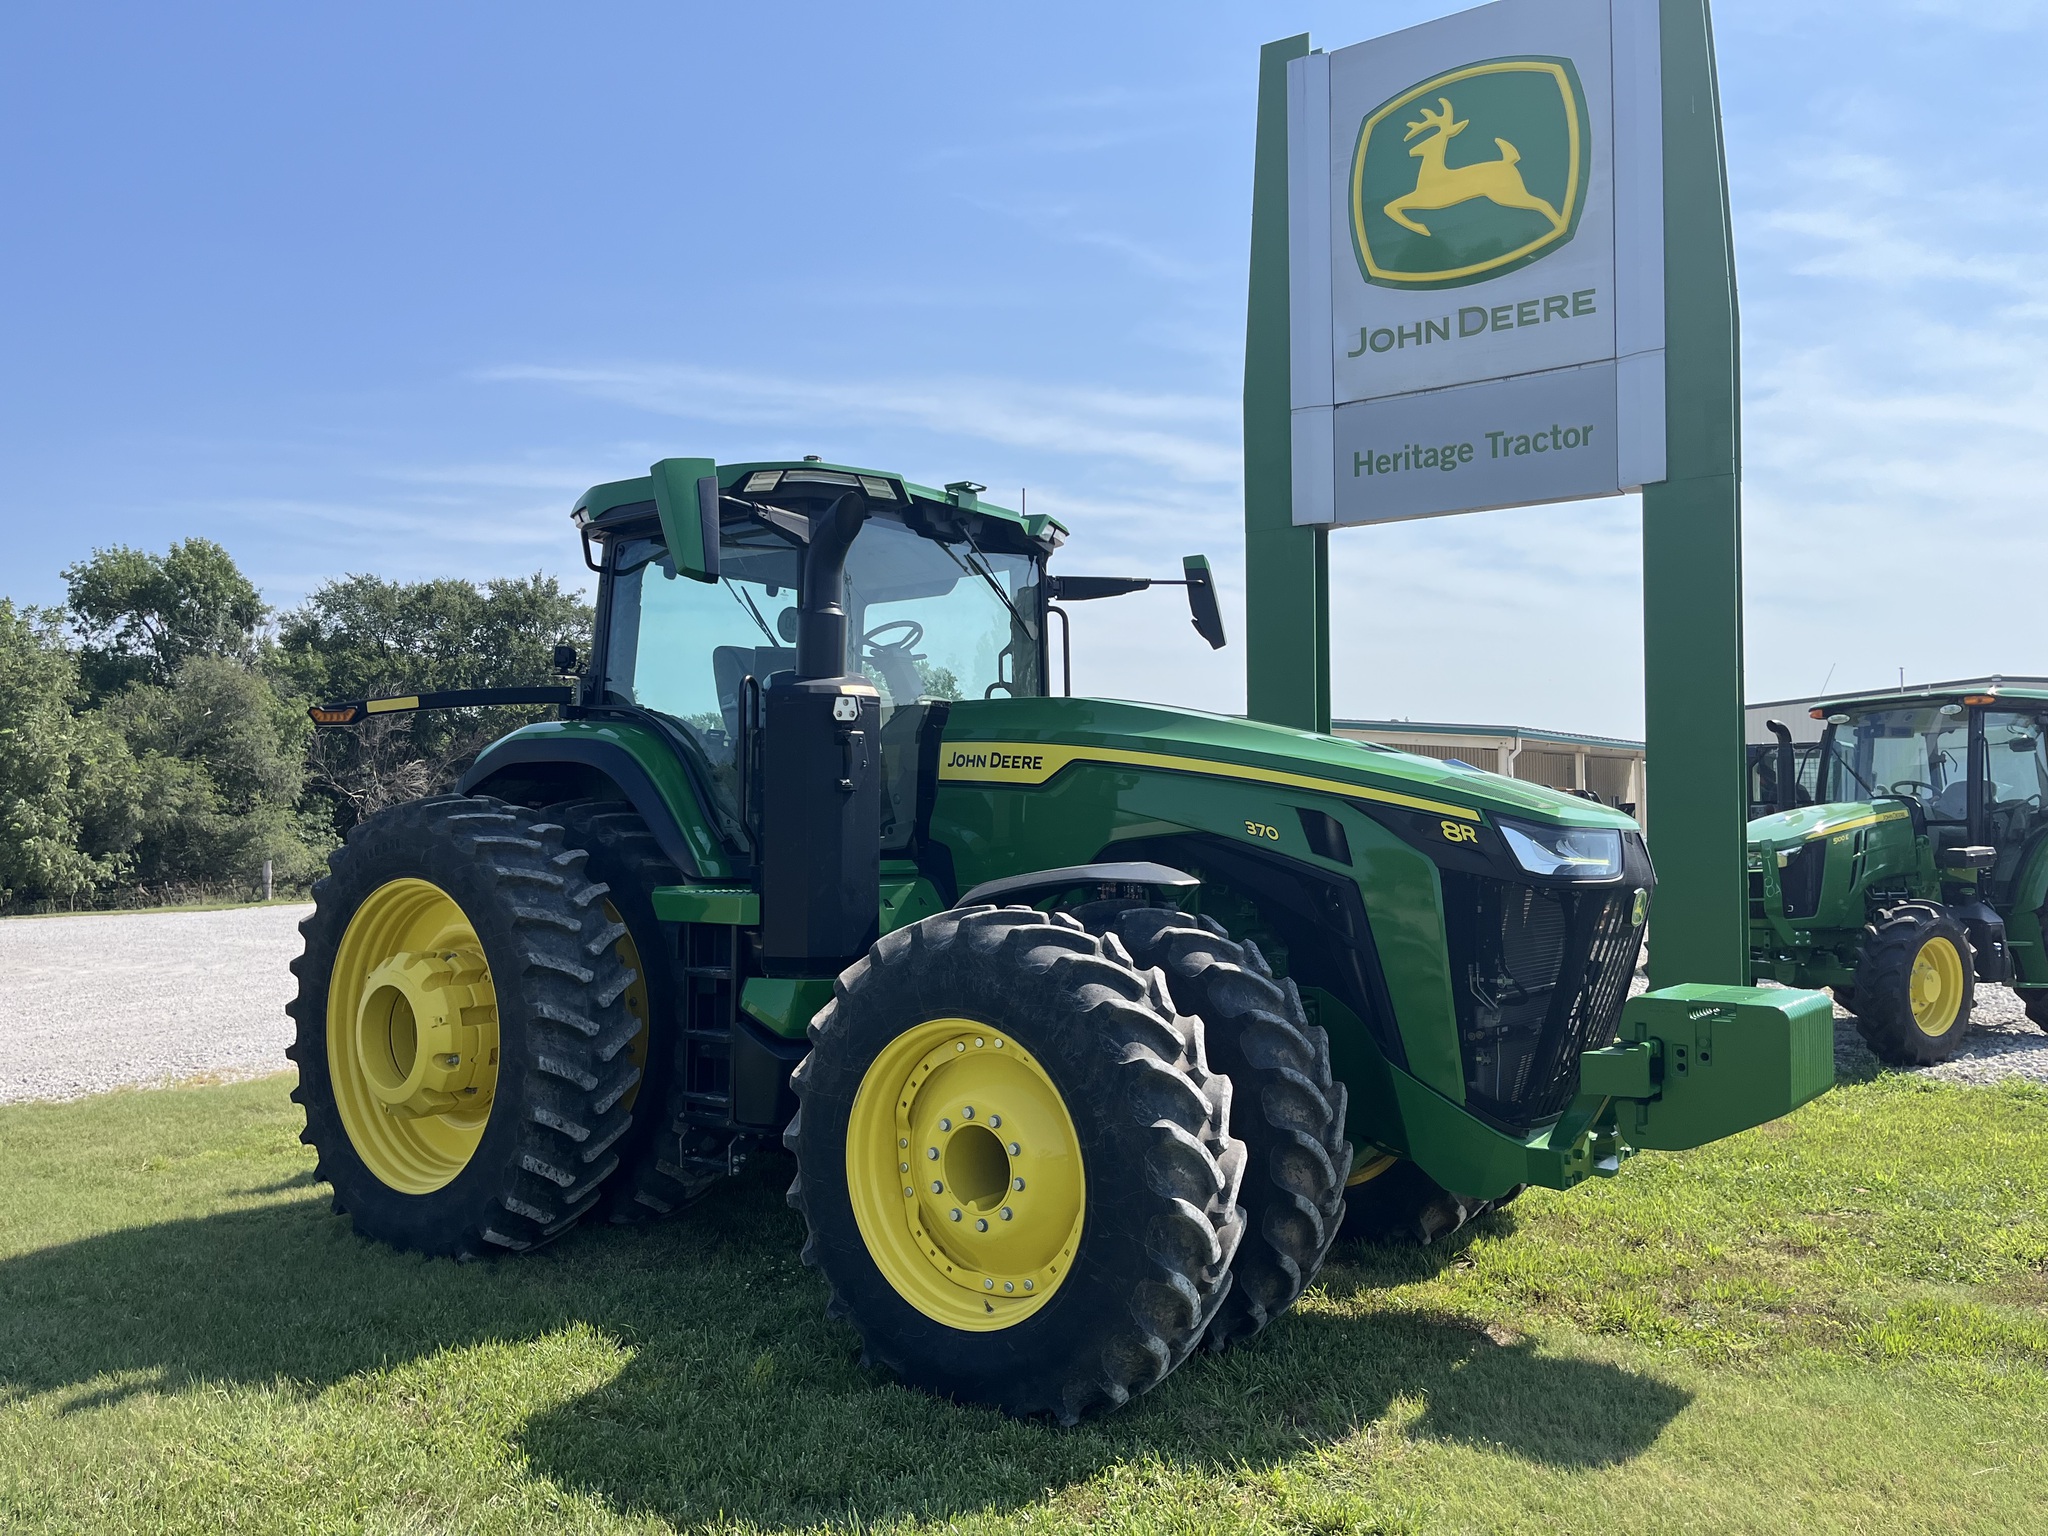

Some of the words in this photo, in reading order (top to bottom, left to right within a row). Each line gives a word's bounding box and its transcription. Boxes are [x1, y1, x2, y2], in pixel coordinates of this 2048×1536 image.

[1347, 317, 1450, 358] JOHN
[1458, 288, 1597, 339] DEERE
[1353, 442, 1474, 478] Heritage
[1484, 424, 1594, 459] Tractor
[947, 751, 987, 768] JOHN
[989, 751, 1043, 770] DEERE
[1244, 819, 1280, 842] 370
[1440, 820, 1479, 845] 8R
